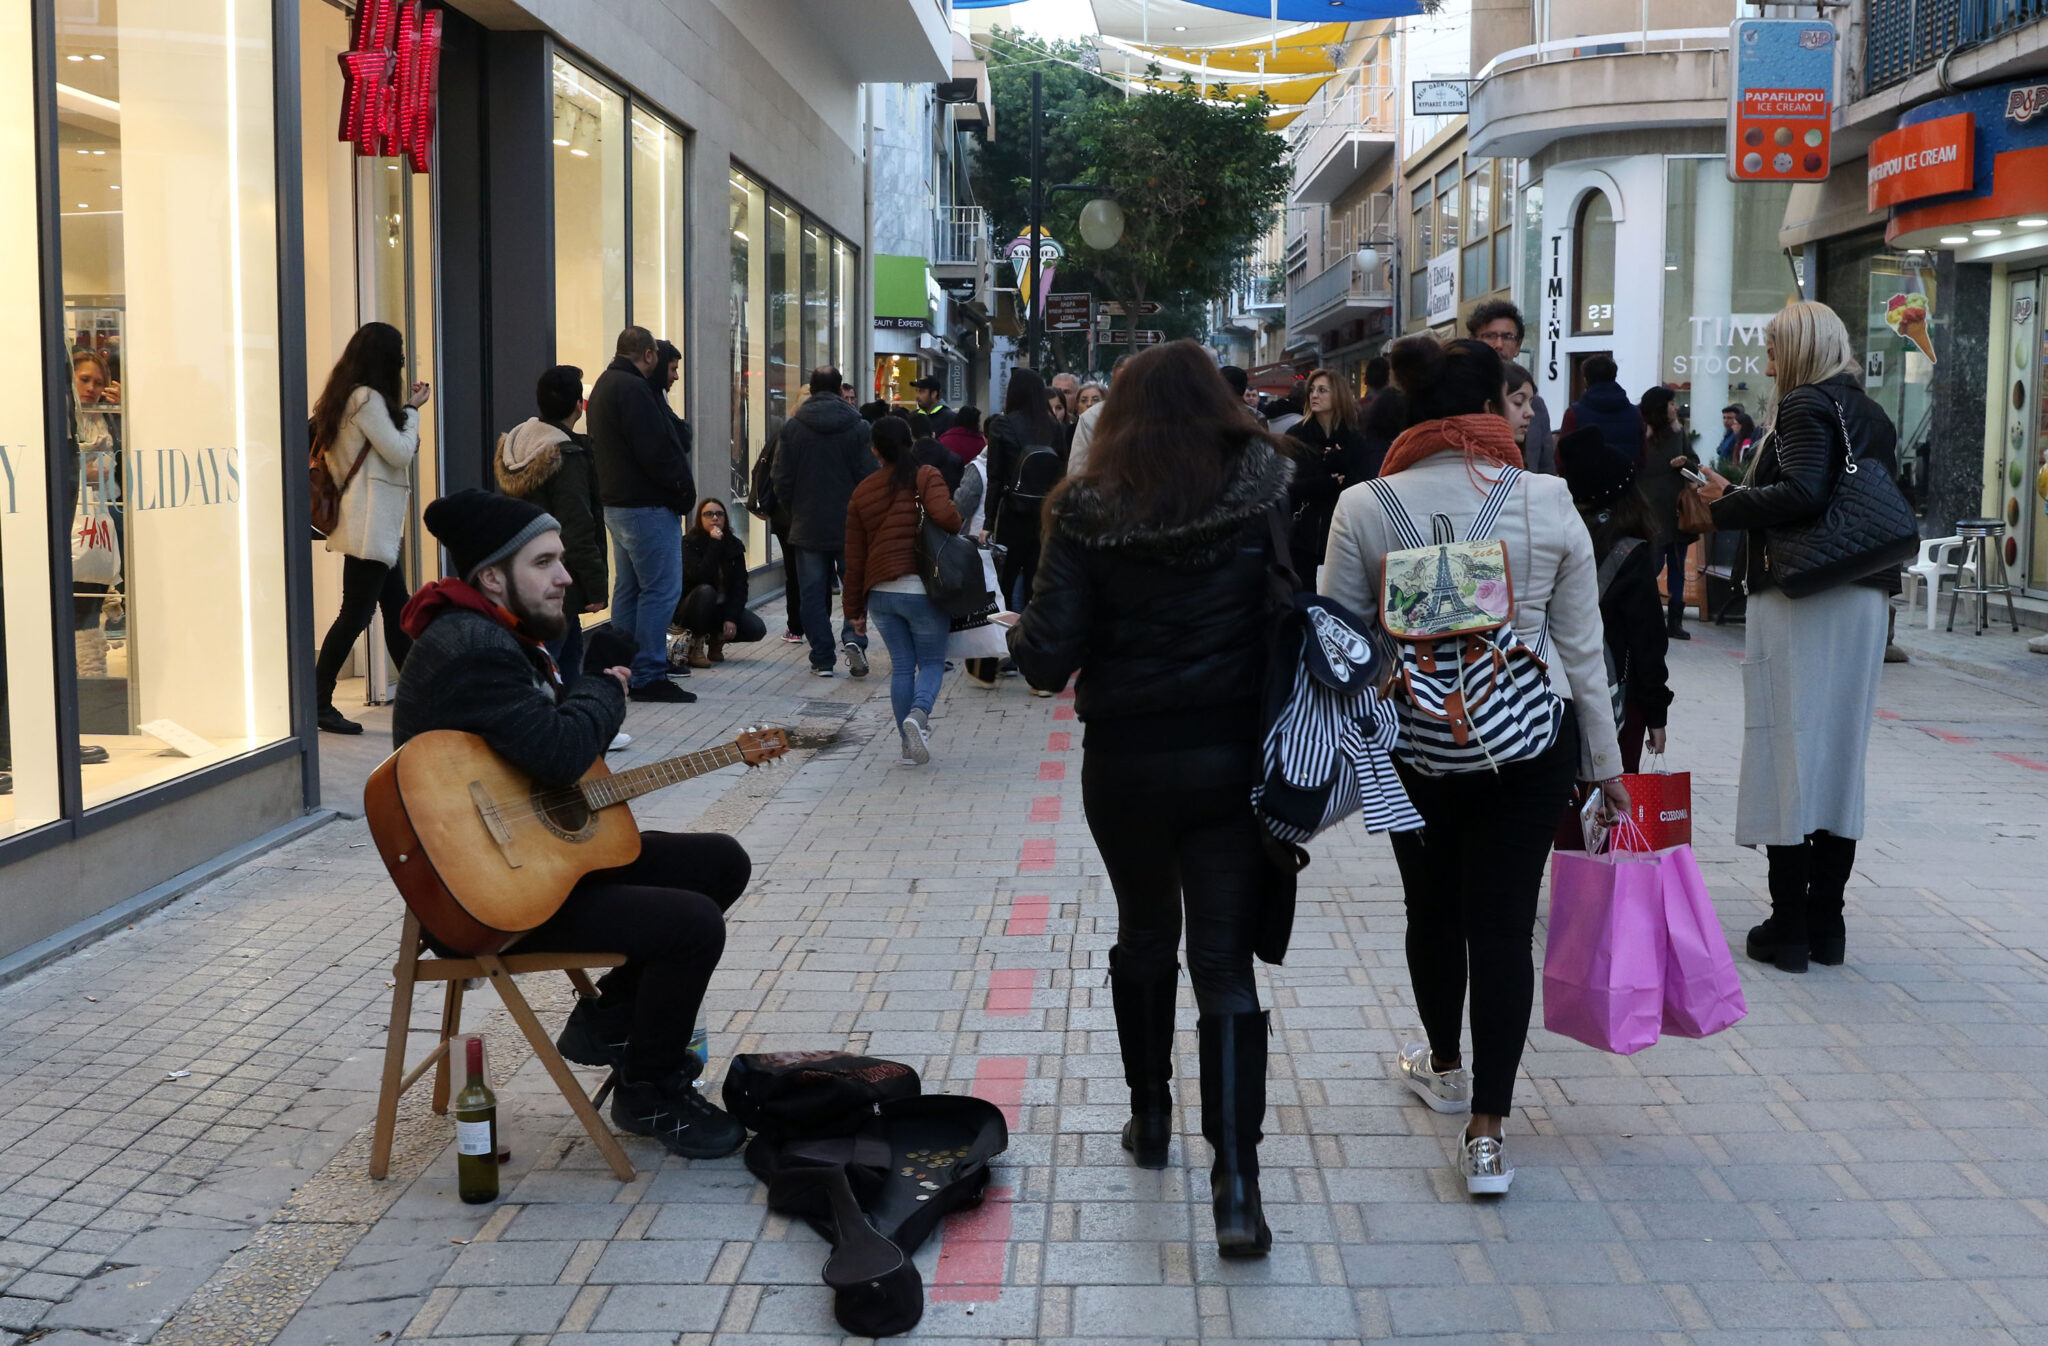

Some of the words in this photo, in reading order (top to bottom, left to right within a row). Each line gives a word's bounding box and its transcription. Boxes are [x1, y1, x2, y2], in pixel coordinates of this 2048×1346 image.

[1757, 103, 1772, 111] ICE
[1776, 103, 1811, 112] CREAM
[1904, 152, 1918, 171] ICE
[1919, 144, 1957, 167] CREAM
[1673, 355, 1761, 375] STOCK
[75, 447, 241, 516] HOLIDAYS
